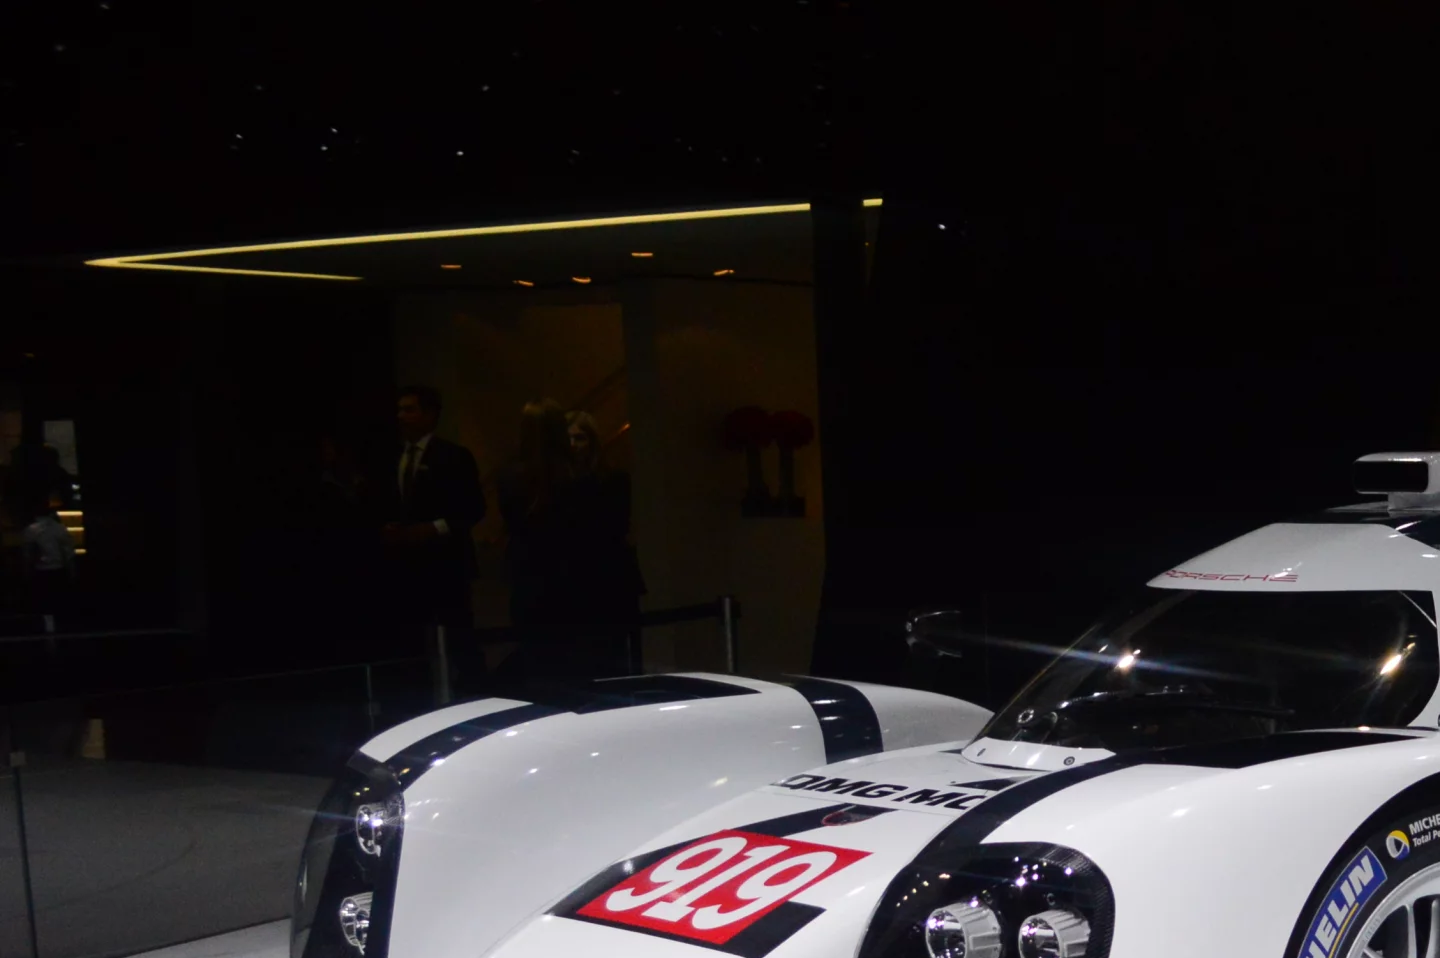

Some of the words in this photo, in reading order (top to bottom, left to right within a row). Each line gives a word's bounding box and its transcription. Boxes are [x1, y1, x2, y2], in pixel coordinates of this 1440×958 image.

[1165, 569, 1300, 583] PORSCHE
[781, 774, 909, 799] DMG
[1412, 831, 1432, 847] Total
[605, 836, 838, 931] 919
